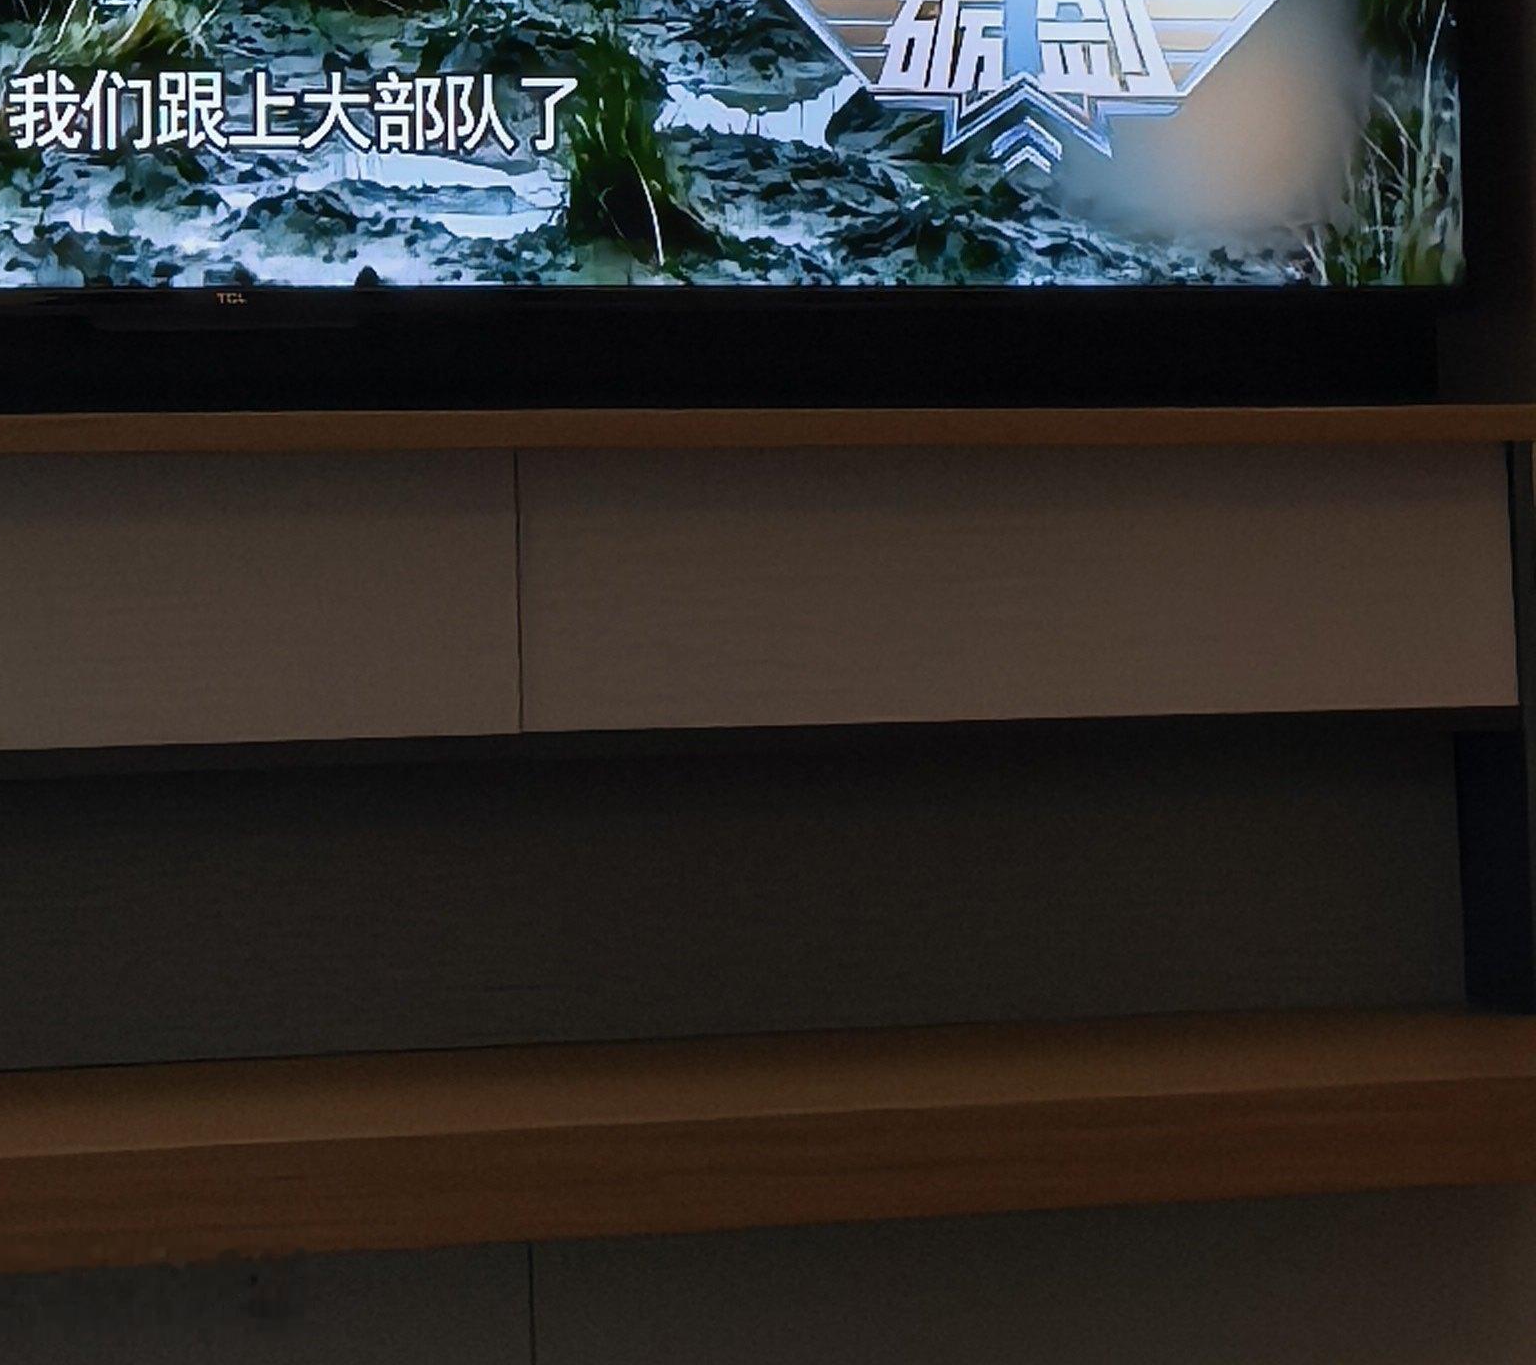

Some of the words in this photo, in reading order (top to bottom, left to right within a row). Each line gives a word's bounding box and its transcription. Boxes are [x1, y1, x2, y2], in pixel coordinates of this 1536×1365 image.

[8, 68, 580, 152] 我们跟上大部队了
[216, 292, 248, 305] TCL
